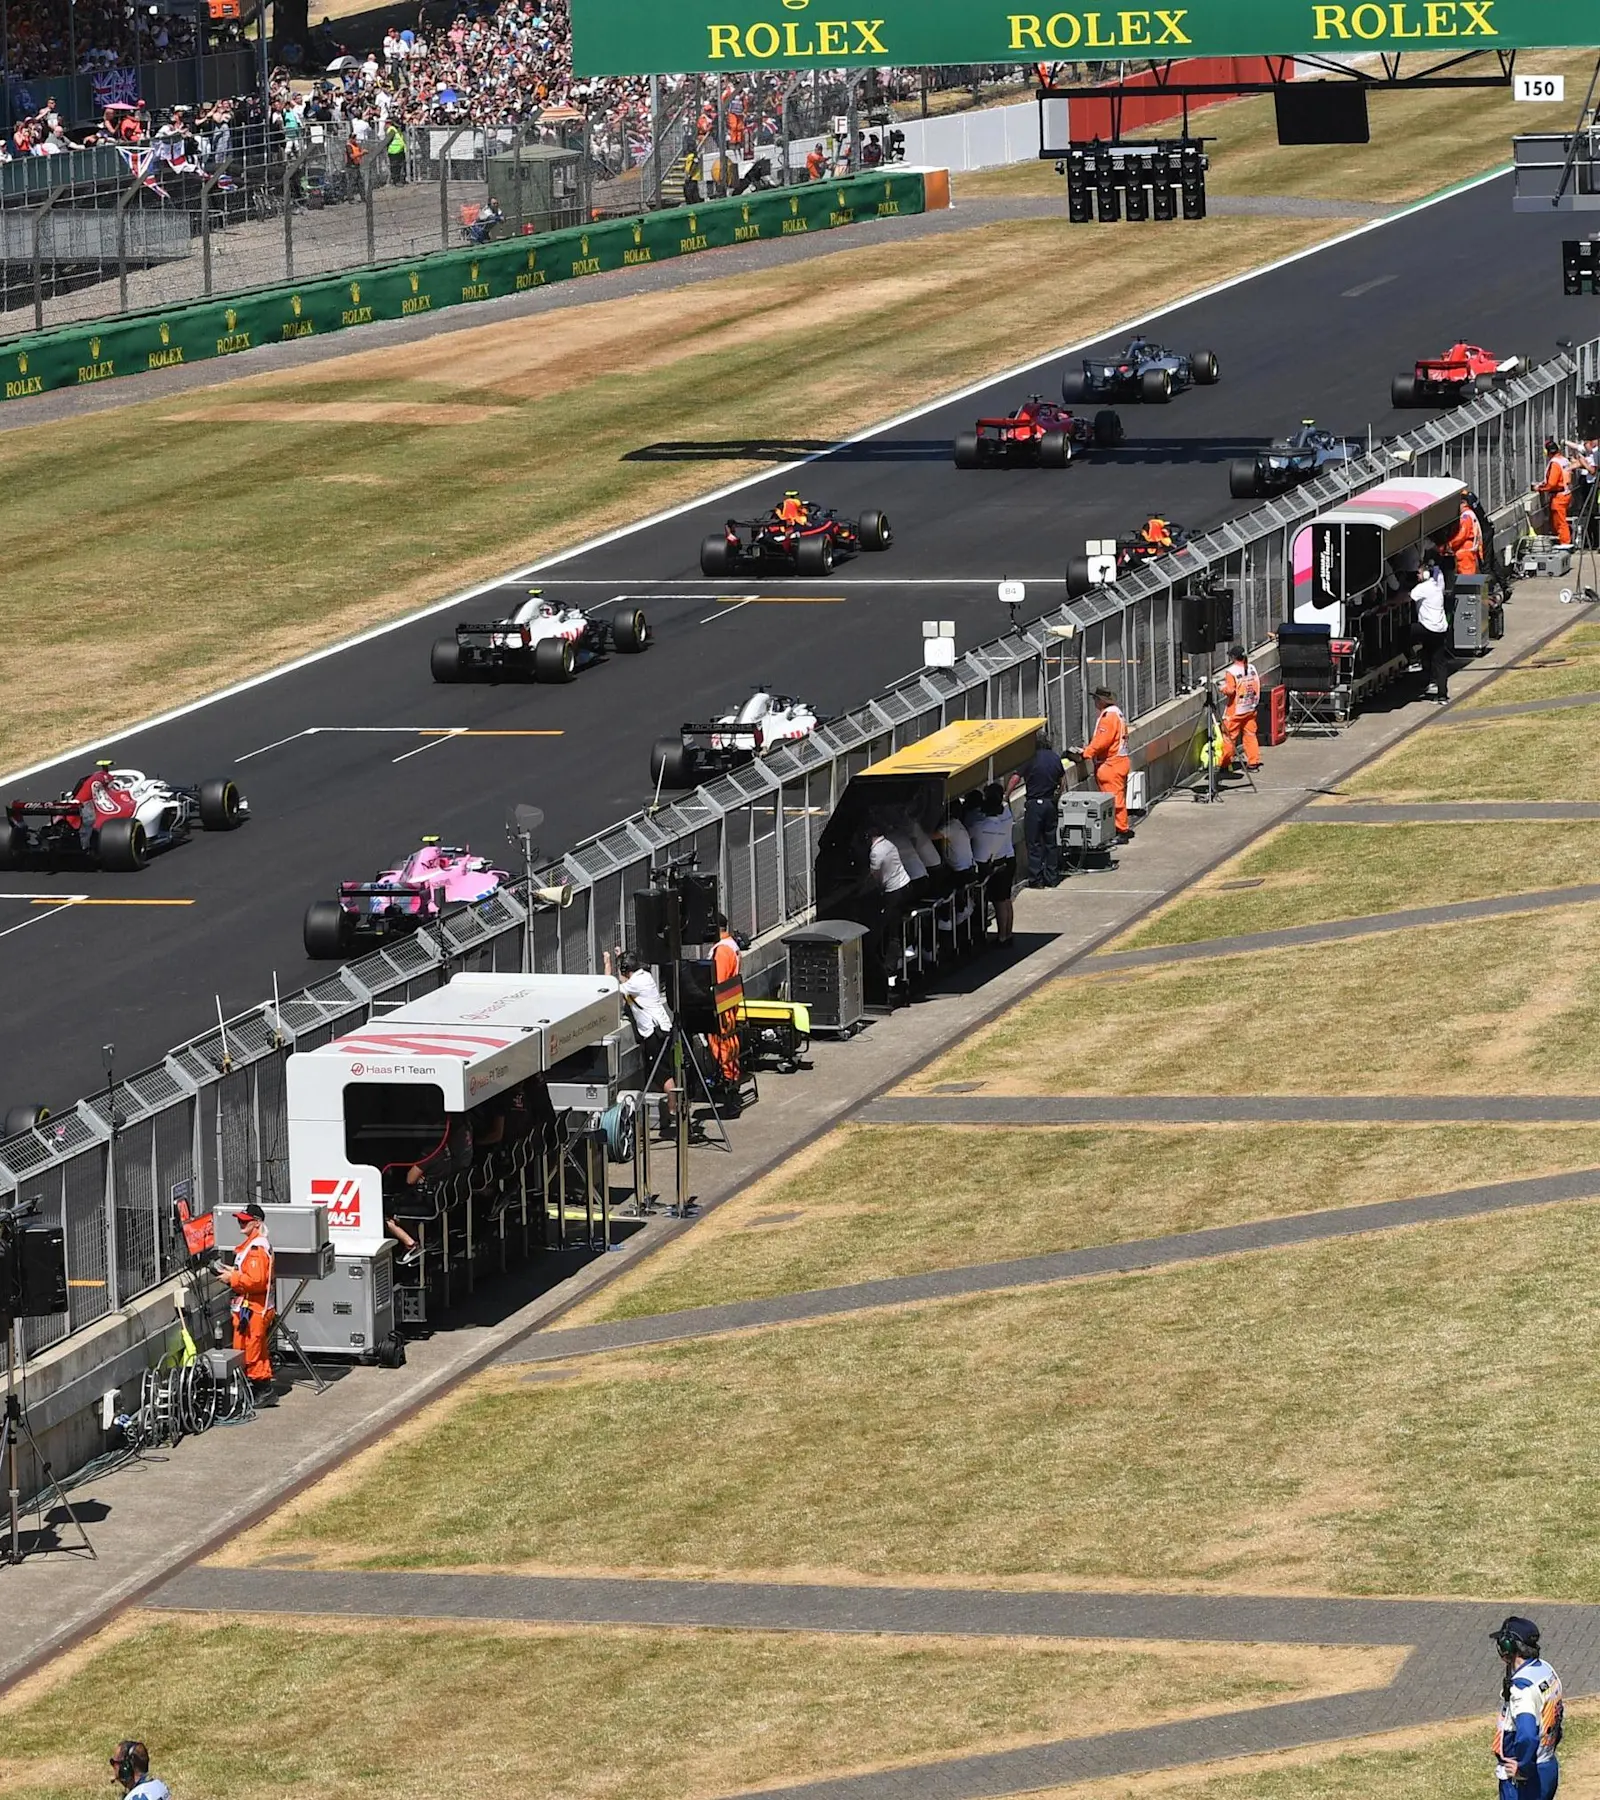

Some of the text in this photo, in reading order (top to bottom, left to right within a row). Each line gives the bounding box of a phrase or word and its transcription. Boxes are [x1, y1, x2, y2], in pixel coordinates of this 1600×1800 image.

[1315, 1, 1496, 39] ROLEX
[1010, 10, 1190, 49] ROLEX
[711, 20, 887, 58] ROLEX
[1524, 81, 1555, 97] 150
[837, 118, 846, 132] F
[735, 225, 760, 241] ROLEX
[782, 218, 807, 233] ROLEX
[680, 235, 707, 253] ROLEX
[623, 248, 650, 264] ROLEX
[572, 257, 600, 274] ROLEX
[516, 271, 545, 289] ROLEX
[462, 284, 490, 301] ROLEX
[402, 295, 430, 313] ROLEX
[342, 307, 371, 325] ROLEX
[217, 333, 250, 353] ROLEX
[148, 347, 184, 367] ROLEX
[79, 361, 114, 382] ROLEX
[6, 376, 42, 397] ROLEX
[366, 1065, 436, 1075] Haas F1 Team
